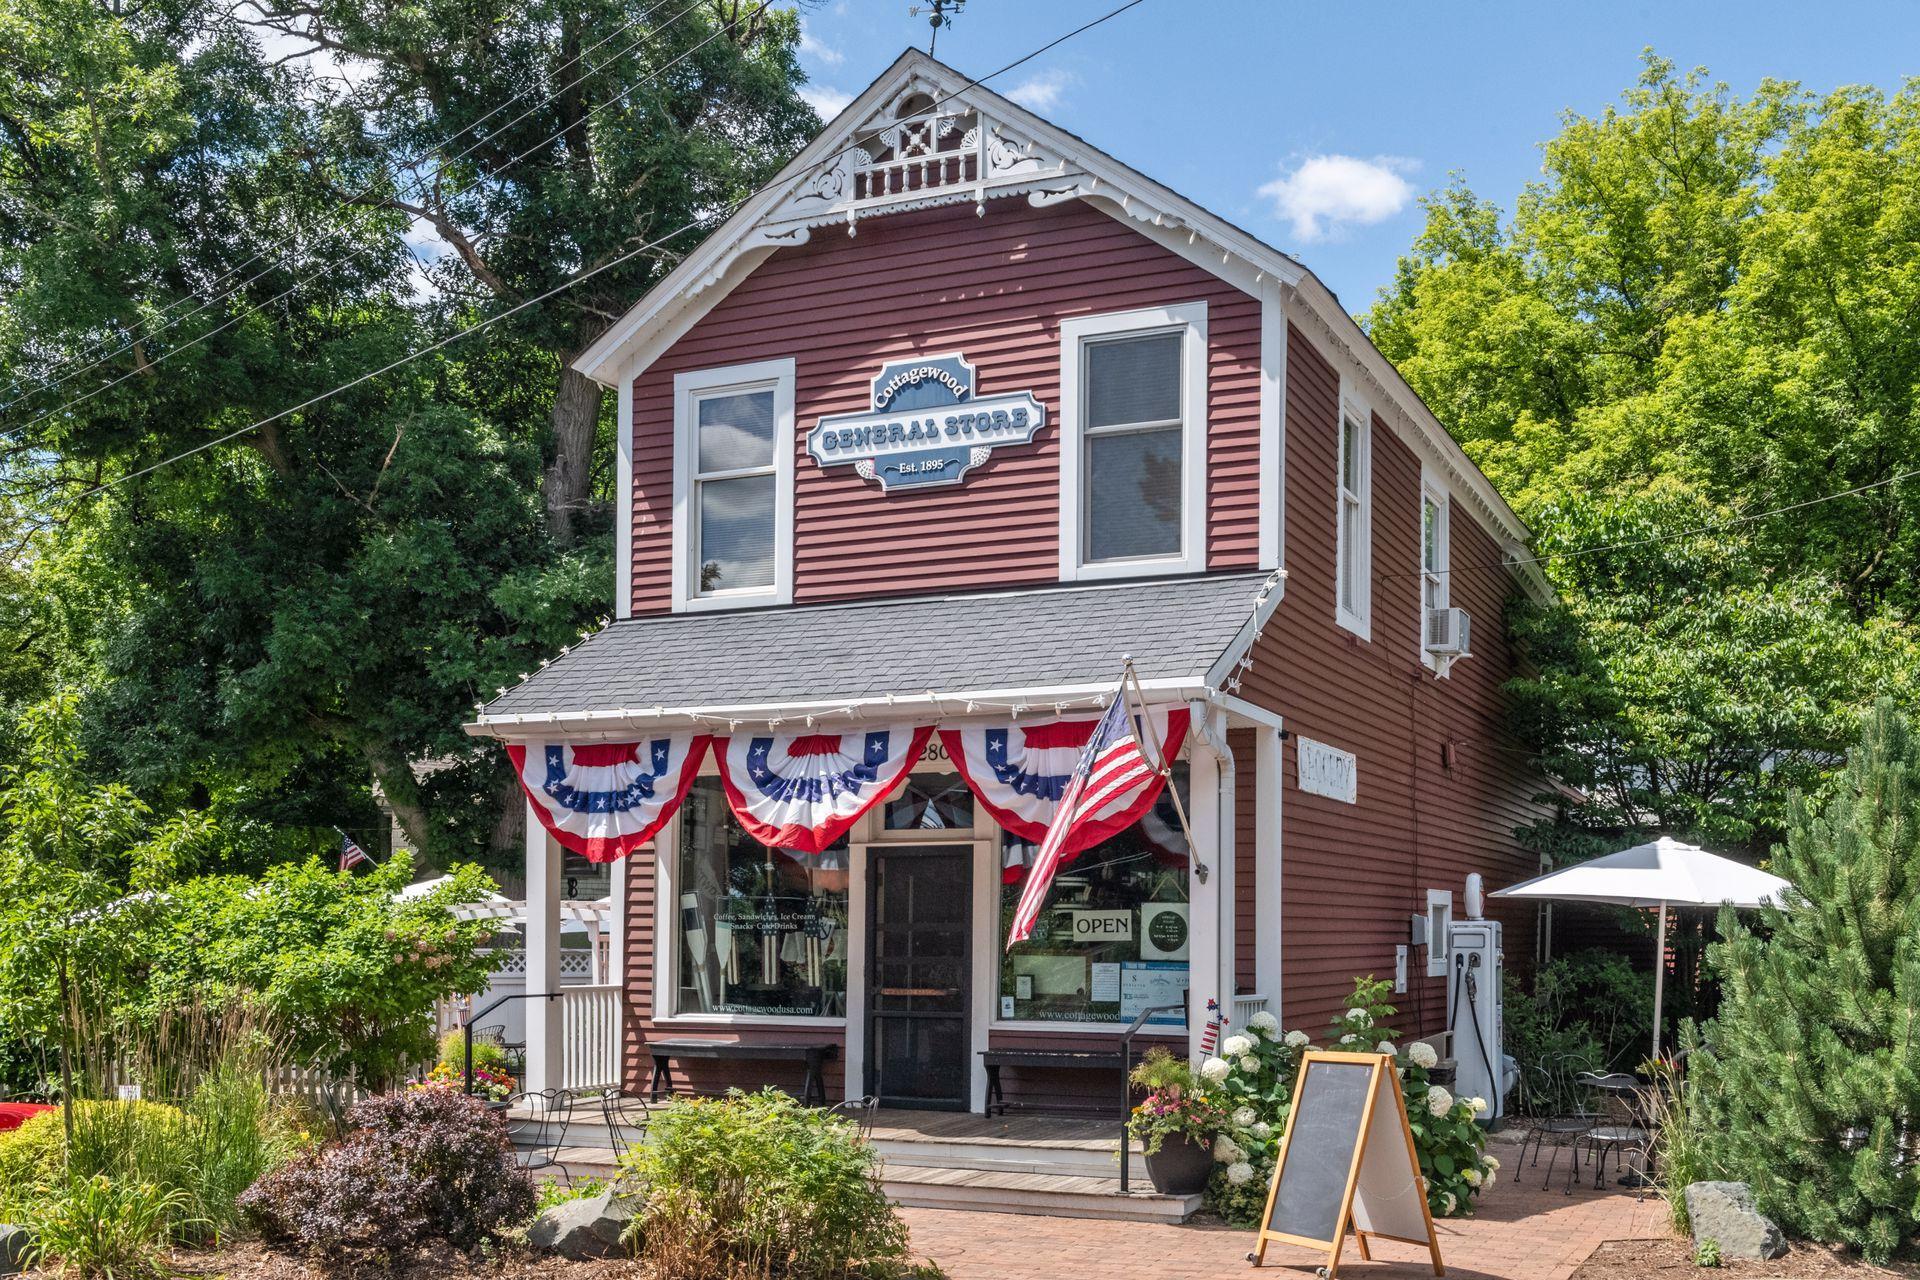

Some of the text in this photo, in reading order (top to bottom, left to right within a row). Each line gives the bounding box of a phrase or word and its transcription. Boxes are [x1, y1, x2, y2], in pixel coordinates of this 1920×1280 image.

[874, 366, 969, 409] Cottagewood
[822, 407, 1028, 450] GENERAL STORE
[899, 459, 944, 474] Est. 1895
[713, 913, 737, 921] Coffee,
[738, 912, 779, 921] Sandwiches,
[780, 912, 791, 920] Ice
[774, 922, 798, 930] Drinks
[1076, 917, 1129, 933] OPEN
